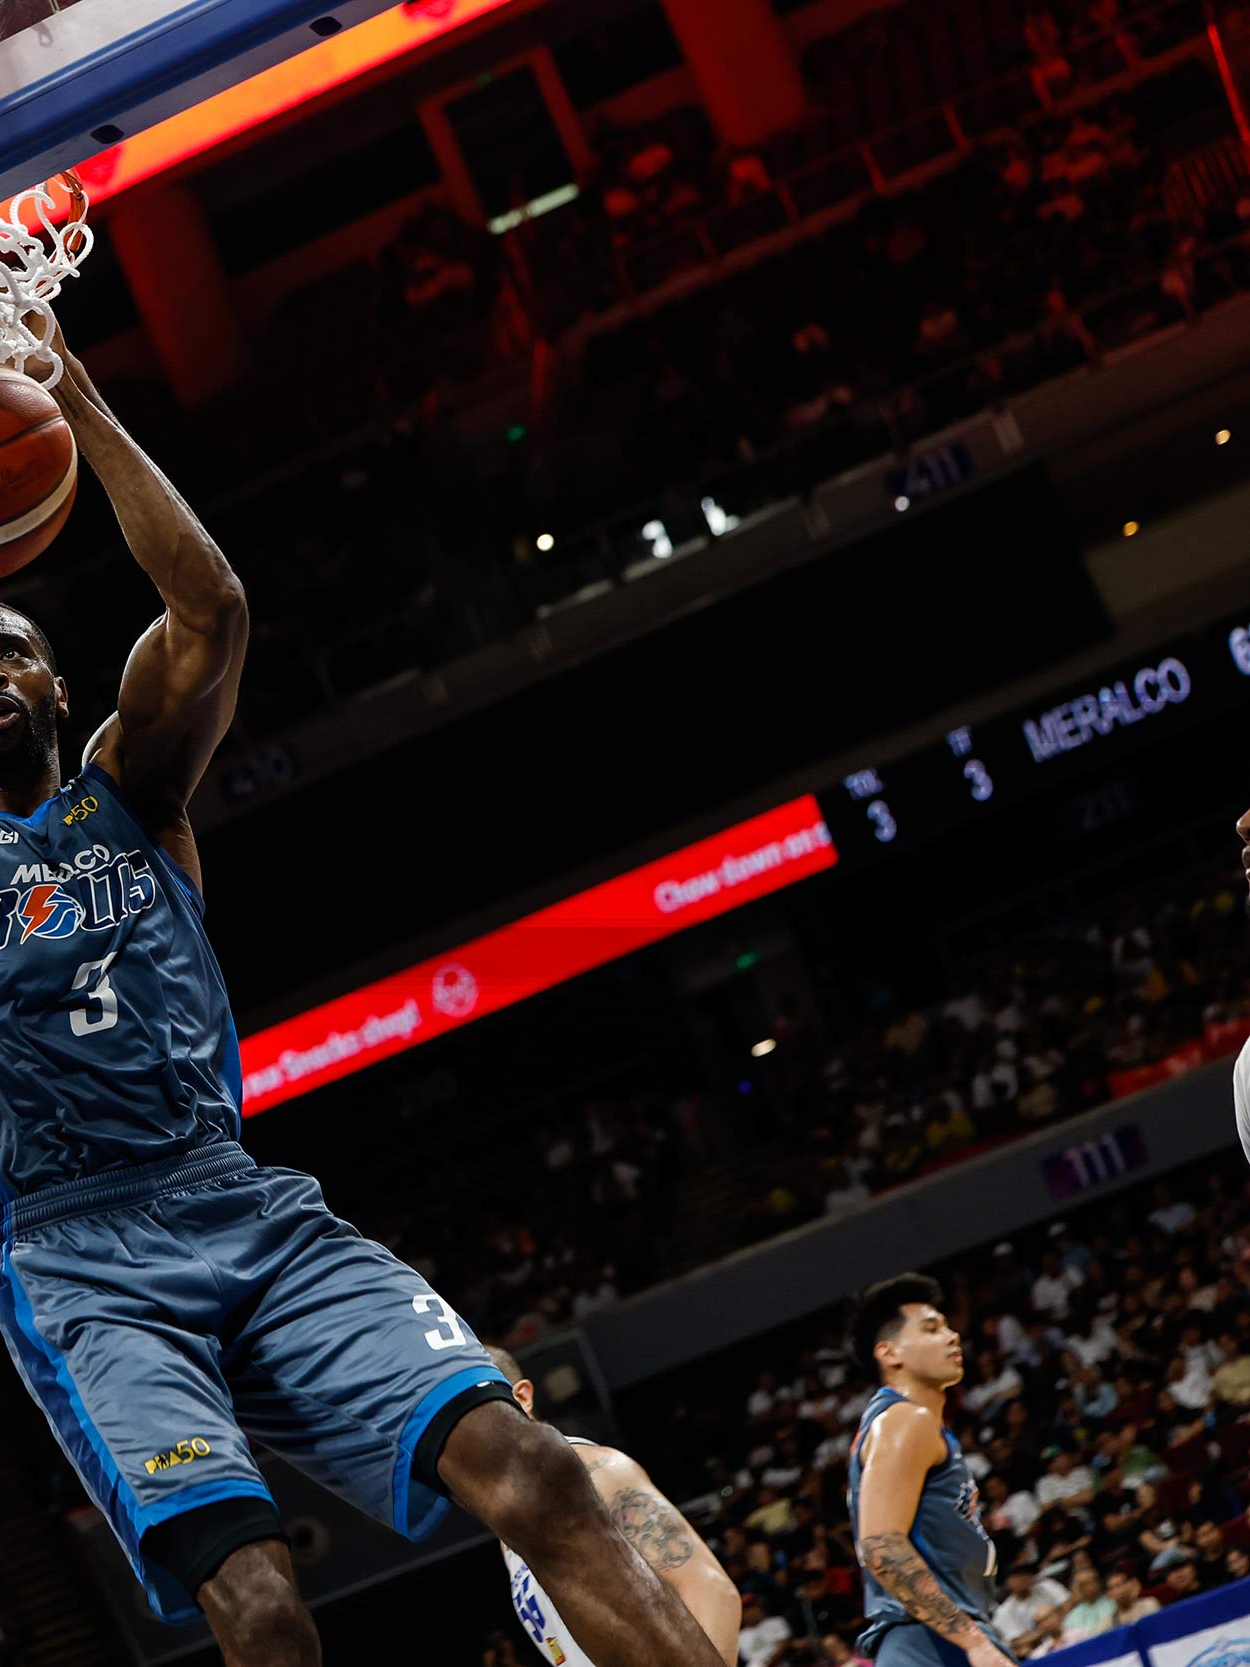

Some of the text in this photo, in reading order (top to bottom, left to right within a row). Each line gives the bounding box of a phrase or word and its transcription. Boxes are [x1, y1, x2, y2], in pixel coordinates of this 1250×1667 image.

[1022, 657, 1191, 763] MERALCO
[963, 758, 993, 801] 3
[866, 799, 897, 843] 3
[70, 951, 118, 1036] 3
[279, 1031, 363, 1081] Snacks
[1063, 1133, 1125, 1186] 111
[412, 1294, 466, 1350] 3
